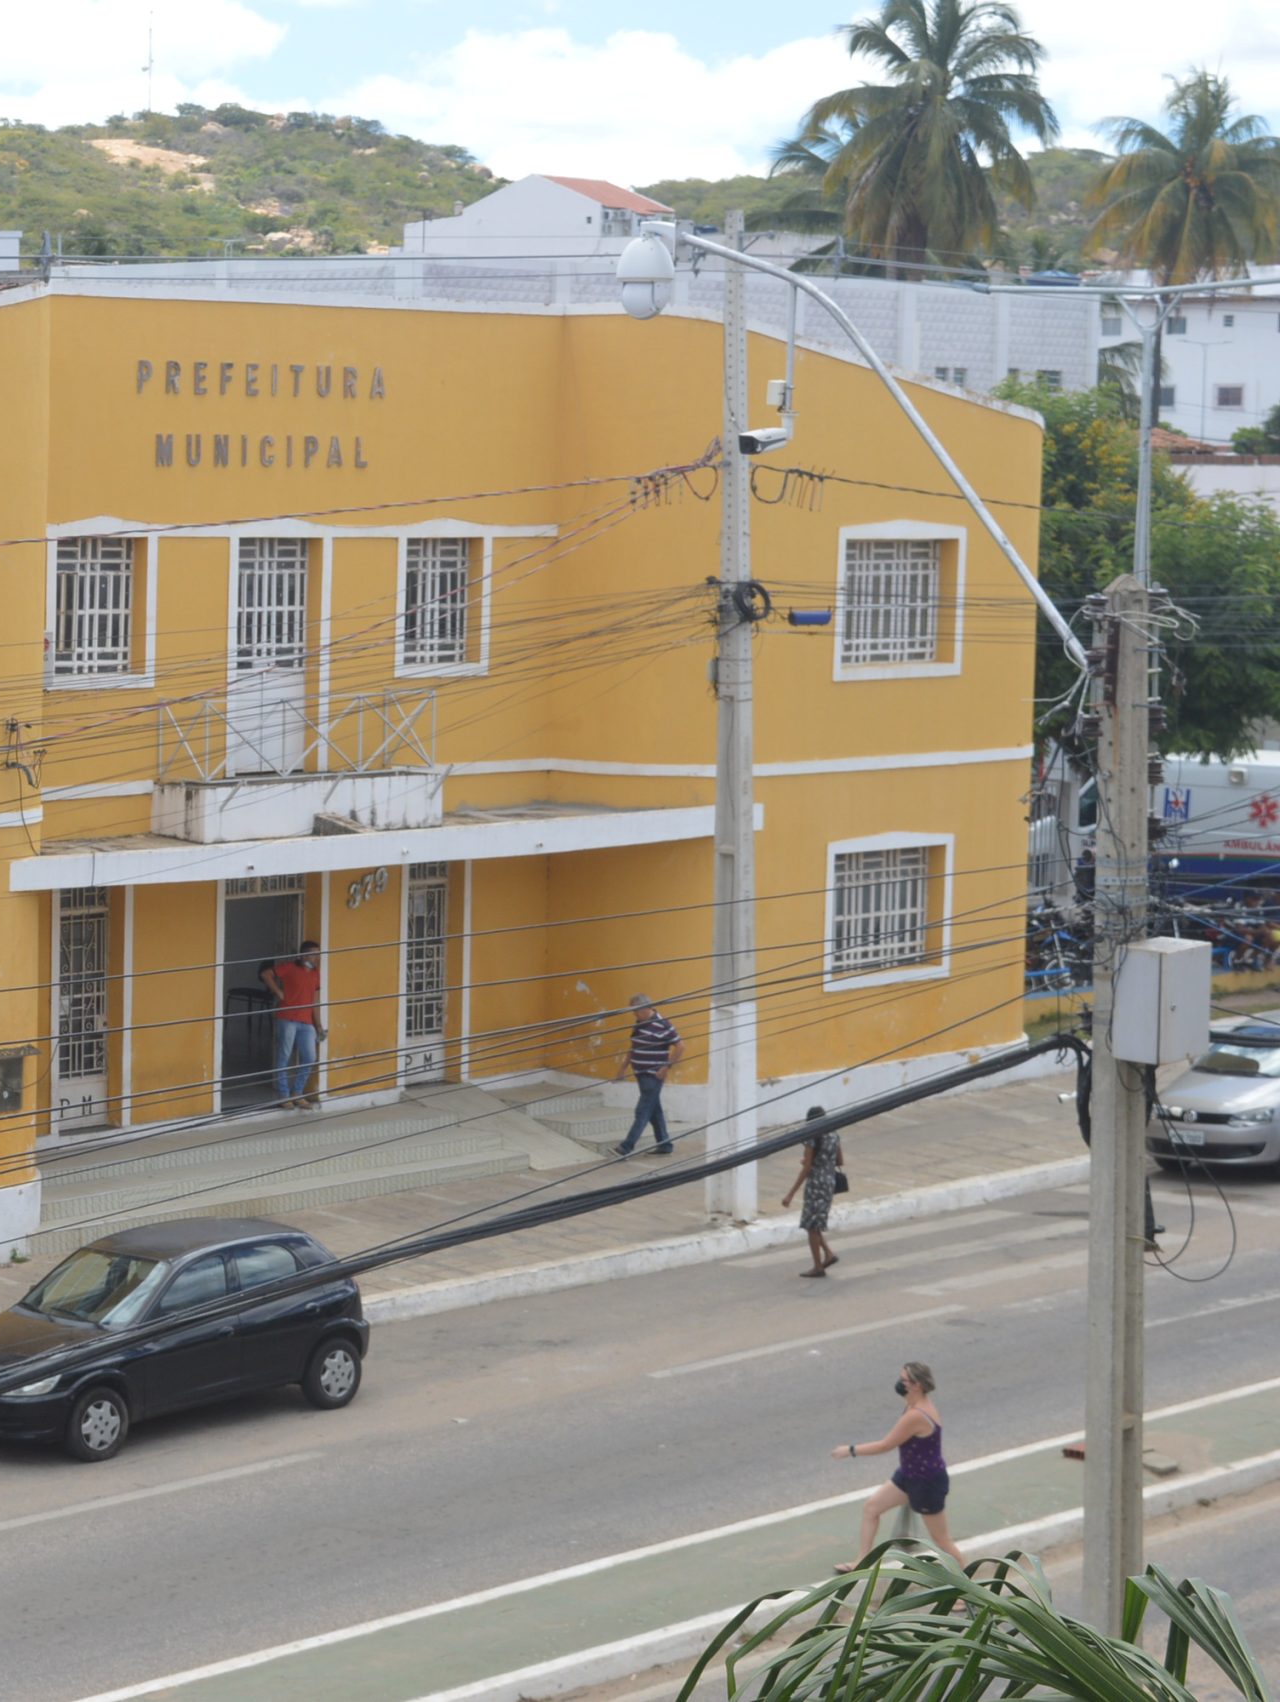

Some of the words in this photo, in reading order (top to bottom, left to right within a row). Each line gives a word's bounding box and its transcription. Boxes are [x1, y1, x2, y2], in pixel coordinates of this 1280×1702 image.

[136, 360, 386, 399] PREFEITURA
[155, 433, 369, 468] MUNICIPAL
[346, 867, 388, 909] 379
